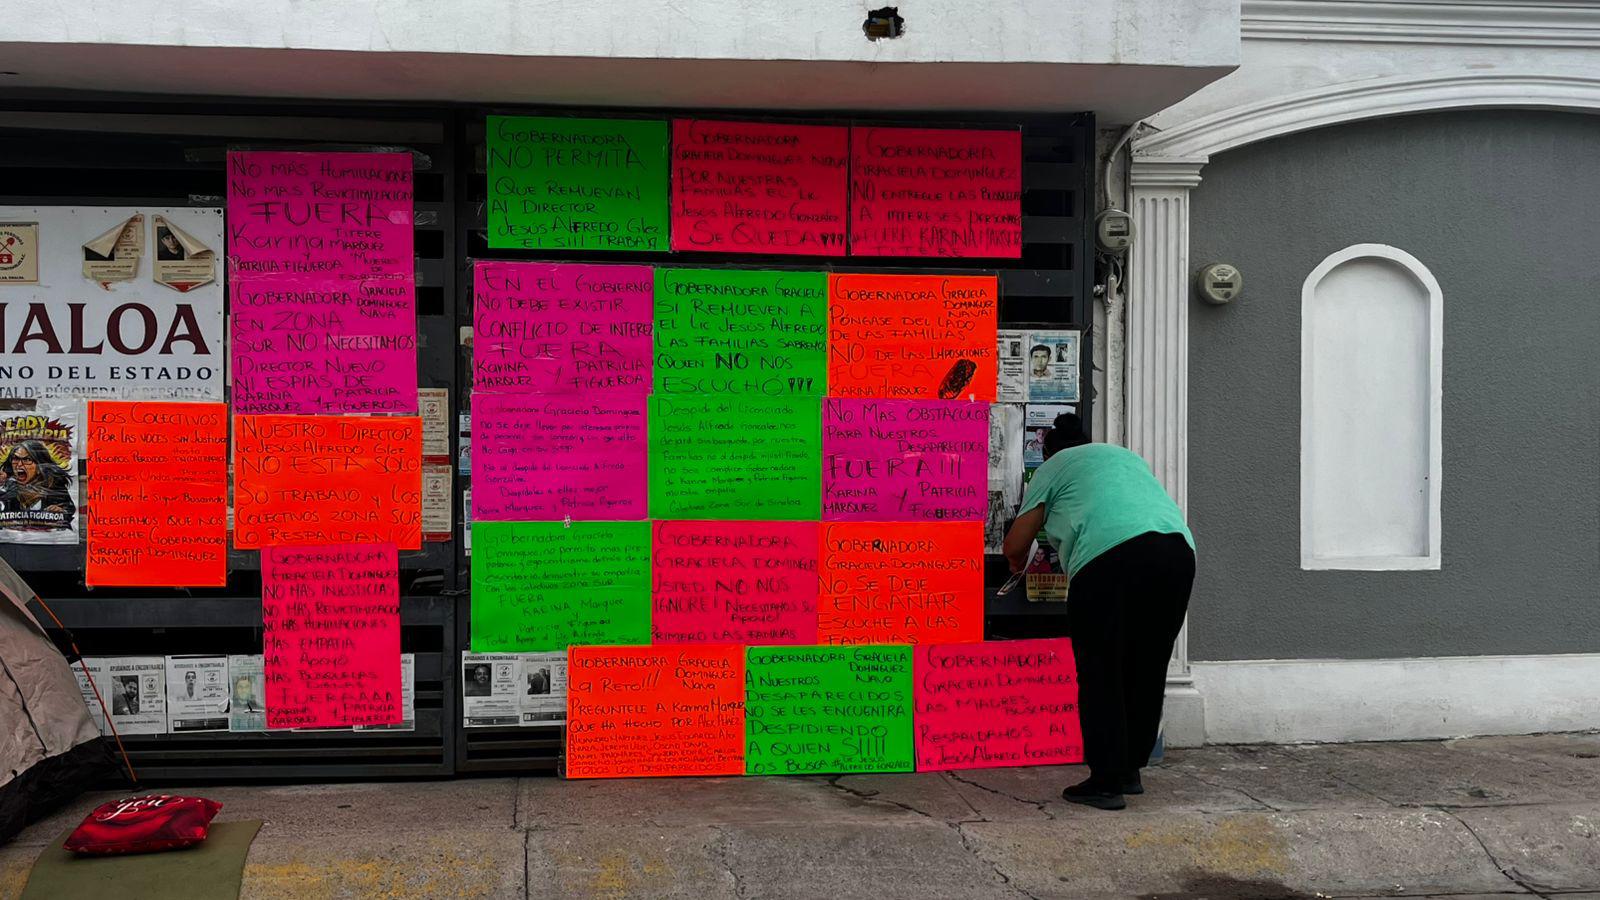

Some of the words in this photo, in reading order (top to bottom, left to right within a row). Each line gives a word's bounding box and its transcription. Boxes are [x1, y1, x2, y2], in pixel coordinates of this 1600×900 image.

[499, 119, 629, 148] GOBERNADORA
[491, 147, 533, 169] NO
[544, 147, 648, 171] PERMITA
[496, 177, 537, 196] QUE
[545, 178, 641, 201] REMUEVAN
[248, 200, 394, 226] FUERA
[522, 200, 598, 214] DIRECTOR
[484, 267, 522, 291] EN
[575, 273, 653, 293] GOBIERNO
[664, 270, 769, 297] GOBERNADORA
[774, 278, 826, 298] GRACIELA
[835, 276, 937, 301] GOBERNADORA
[941, 279, 988, 300] GRACIELA
[237, 281, 352, 306] GOBERNADORA
[477, 293, 501, 312] NO
[508, 296, 552, 311] DEBE
[559, 298, 628, 312] EXISTIR
[690, 299, 790, 316] REMUEVEN
[800, 303, 816, 318] A
[0, 303, 211, 355] ALOA
[235, 312, 264, 330] EN
[271, 310, 345, 331] ZONA
[478, 313, 569, 340] CONFLICTO
[902, 316, 931, 327] DEL
[938, 316, 976, 331] LADO
[235, 332, 275, 352] SUR
[287, 332, 318, 352] NO
[326, 331, 415, 351] NECESITAMOS
[657, 332, 689, 348] LAS
[695, 335, 770, 349] FAMILIAS
[830, 329, 852, 341] DE
[856, 330, 886, 340] LAS
[888, 329, 966, 341] FAMILIAS
[487, 340, 626, 358] FUERA
[830, 342, 865, 362] NO
[874, 351, 895, 361] DE
[901, 346, 927, 360] LAS
[234, 355, 314, 376] DIRECTOR
[325, 355, 386, 373] NUEVO
[715, 351, 749, 371] NO
[760, 354, 793, 370] NOS
[48, 366, 96, 379] DEL
[110, 366, 212, 380] ESTADO
[235, 376, 257, 394] NI
[91, 401, 127, 423] LOS
[131, 401, 219, 426] COLECTIVOS
[827, 398, 855, 423] NO
[862, 403, 897, 422] MAS
[5, 415, 48, 430] LADY
[241, 416, 325, 440] NUESTRO
[337, 422, 415, 441] DIRECTOR
[869, 424, 939, 440] NUESTROS
[241, 456, 280, 475] NO
[373, 456, 419, 473] SOLO
[238, 479, 269, 505] SU
[275, 490, 361, 501] TRABAJO
[917, 481, 977, 497] PATRICIA
[0, 511, 29, 521] ATRICIA
[30, 511, 64, 521] FIGUEROA
[238, 507, 319, 526] COLECTIVOS
[330, 510, 378, 521] ZONA
[391, 508, 420, 525] SUR
[826, 524, 942, 553] GOBERNADORA
[826, 553, 889, 570] GRACIELA
[889, 558, 967, 570] DOMINGUEZ
[816, 573, 848, 595] NO
[855, 574, 879, 592] SE
[887, 573, 929, 591] DEJE
[817, 611, 897, 630] ESCUCHE
[903, 614, 920, 629] A
[926, 614, 960, 629] LAS
[822, 633, 920, 645] FAMILIAS
[572, 647, 670, 668] GOBERNADORA
[678, 649, 731, 668] GRACIELA
[747, 646, 847, 665] GOBERNADORA
[853, 647, 908, 663] GRACIELA
[928, 644, 1061, 669] GOBERNADORA
[674, 667, 737, 679] DOMINGUEZ
[744, 668, 755, 688] A
[759, 672, 821, 688] NUESTROS
[744, 690, 905, 702] DESAPARECIDOS
[569, 697, 649, 718] PREGUNTELE
[656, 702, 668, 713] A
[743, 702, 764, 718] NO
[770, 705, 785, 717] SE
[793, 704, 817, 717] LES
[821, 703, 906, 718] ENCUENTRA
[749, 740, 762, 756] A
[770, 741, 831, 757] QUIEN
